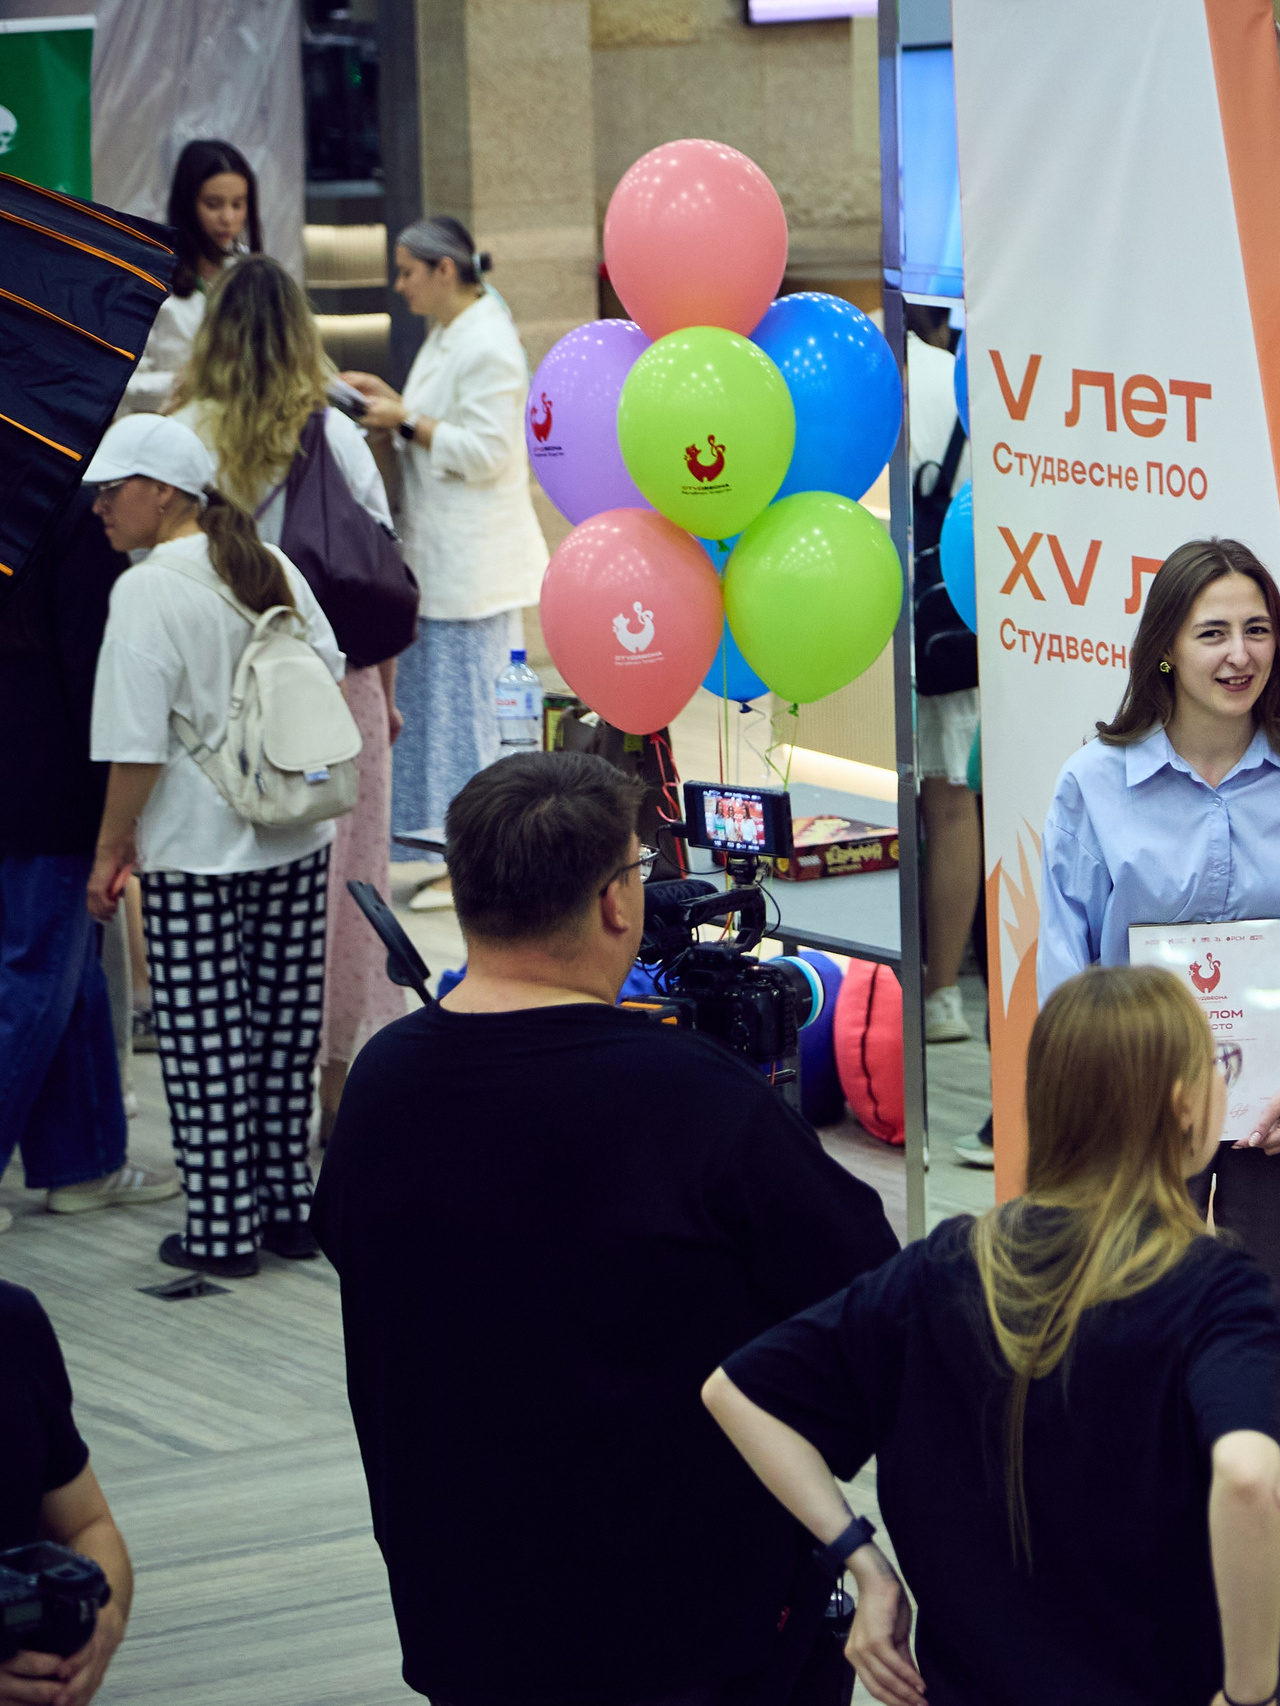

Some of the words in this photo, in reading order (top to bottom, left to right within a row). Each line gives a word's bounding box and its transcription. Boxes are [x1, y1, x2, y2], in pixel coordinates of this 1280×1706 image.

[988, 349, 1042, 421] V
[1065, 368, 1212, 443] лет
[993, 441, 1139, 491] Студвесне
[1146, 460, 1208, 501] ПОО
[997, 526, 1103, 607] XV
[1000, 617, 1134, 669] Студвесн
